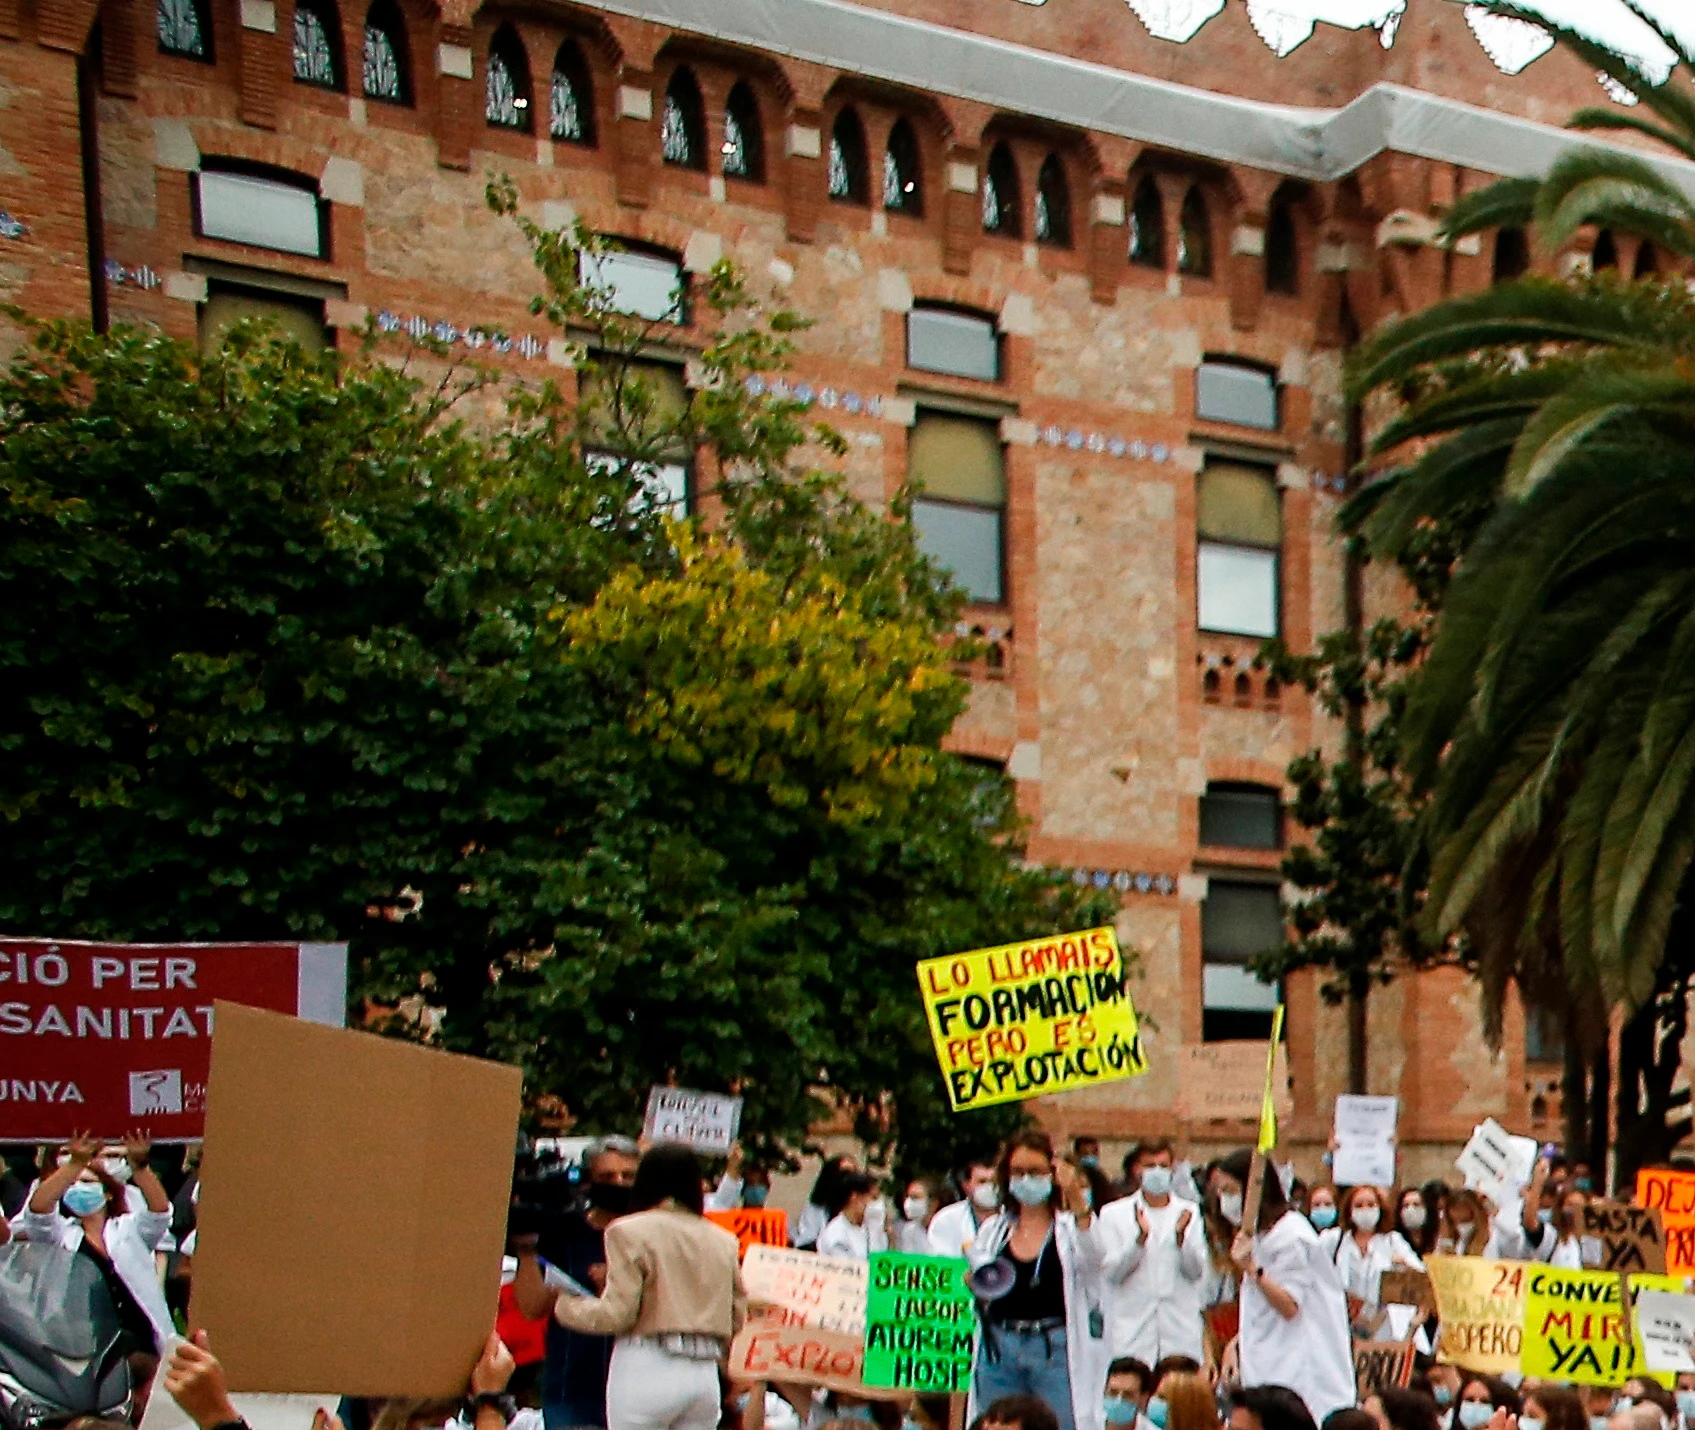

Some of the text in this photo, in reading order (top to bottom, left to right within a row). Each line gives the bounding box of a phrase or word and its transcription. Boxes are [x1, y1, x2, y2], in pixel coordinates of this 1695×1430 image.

[91, 957, 197, 989] PER
[928, 931, 1114, 995] LO LLAMAIS
[947, 1013, 1096, 1067] PERO ES
[1582, 1205, 1658, 1244] BASTA
[1604, 1237, 1647, 1271] YA
[875, 1258, 953, 1291] SENSE
[1492, 1264, 1523, 1298] 24
[868, 1321, 973, 1355] ATUREM
[1540, 1311, 1625, 1343] MIR
[744, 1331, 862, 1377] EXPLO
[1549, 1338, 1635, 1380] YA!!
